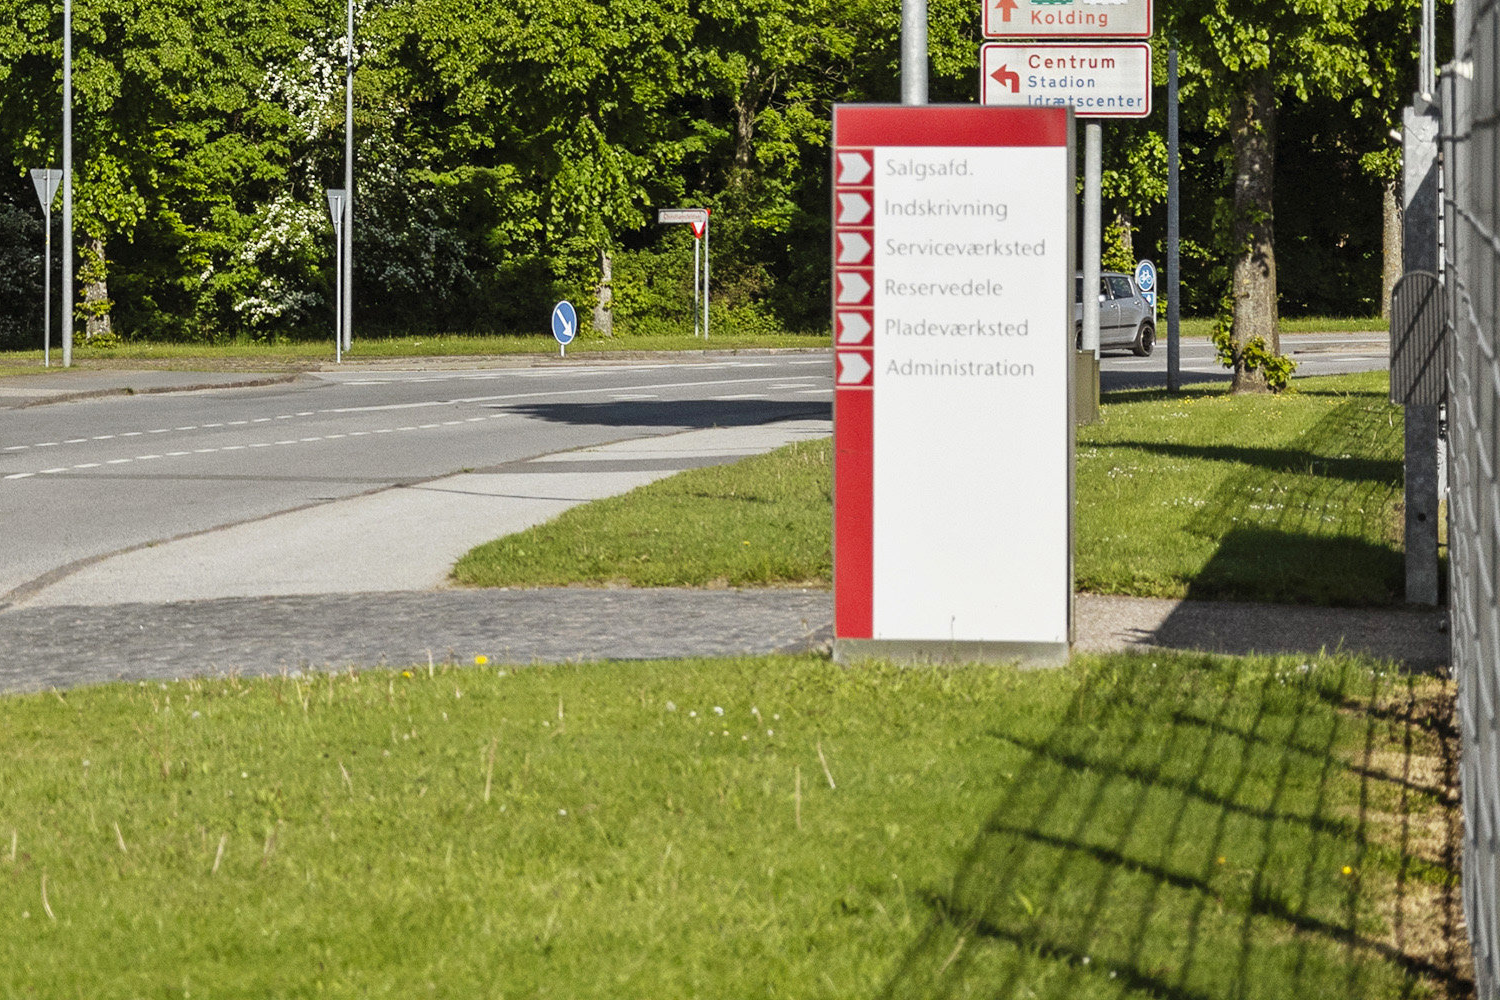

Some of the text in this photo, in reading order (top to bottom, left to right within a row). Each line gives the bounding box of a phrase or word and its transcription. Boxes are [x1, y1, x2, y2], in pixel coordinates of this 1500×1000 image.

[1031, 10, 1108, 27] Kolding
[1028, 54, 1115, 69] Centrum
[1028, 75, 1095, 88] Stadion
[1028, 95, 1142, 107] Idrætscenter
[886, 158, 974, 181] Salgsafd.
[884, 199, 1008, 222] Indskrivning
[886, 238, 1046, 256] Serviceværksted
[885, 278, 1003, 296] Reservedele
[885, 318, 1029, 336] Pladeværksted
[886, 358, 1035, 376] Administration
